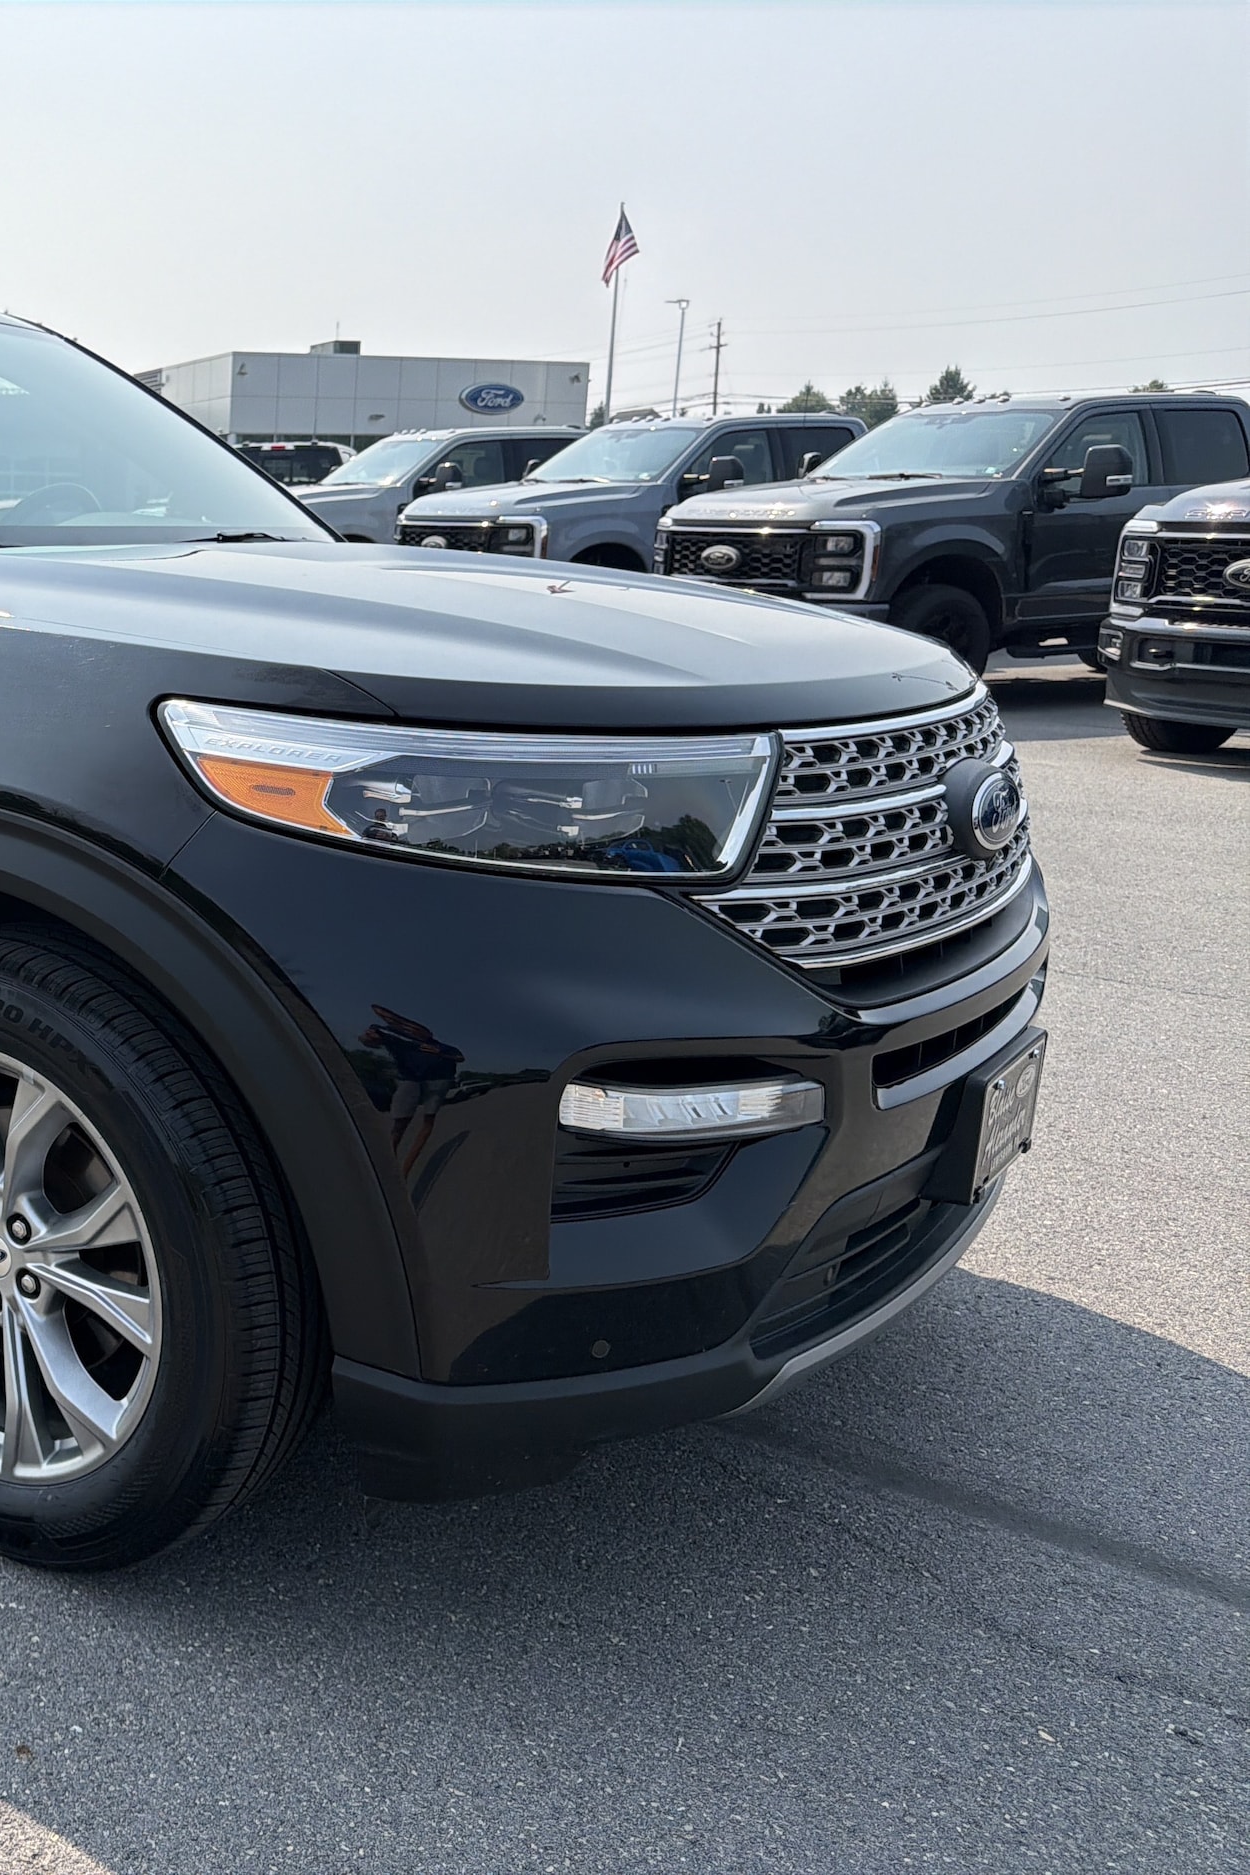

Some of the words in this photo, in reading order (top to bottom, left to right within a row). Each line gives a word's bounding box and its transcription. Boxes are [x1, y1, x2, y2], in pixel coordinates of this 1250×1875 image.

[476, 388, 514, 408] Ford
[204, 737, 343, 763] EXPLORER
[991, 788, 1017, 834] Ford
